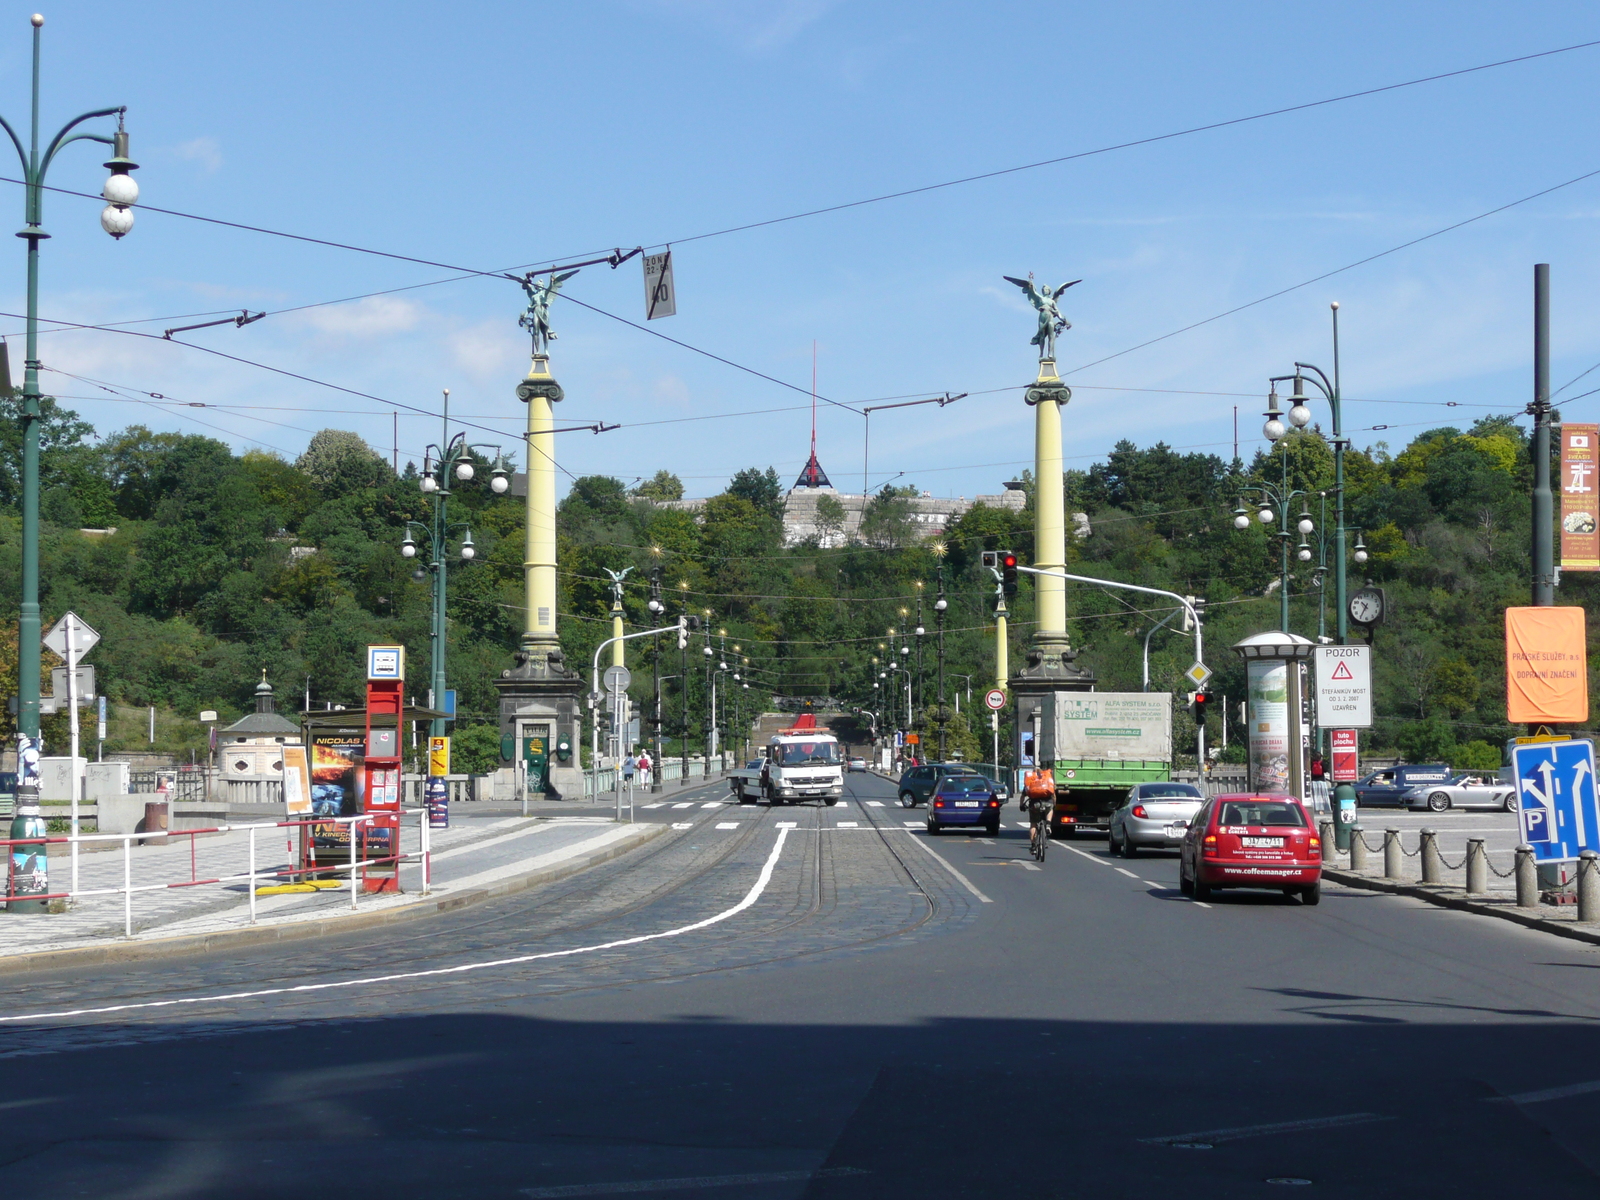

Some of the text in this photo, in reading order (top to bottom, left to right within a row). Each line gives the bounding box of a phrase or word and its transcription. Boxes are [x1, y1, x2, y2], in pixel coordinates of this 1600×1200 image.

[1326, 649, 1359, 657] POZOR
[1550, 669, 1577, 678] ZNAČENÍ
[1526, 812, 1542, 831] P
[1224, 868, 1301, 877] www.coffeemanager.cz
